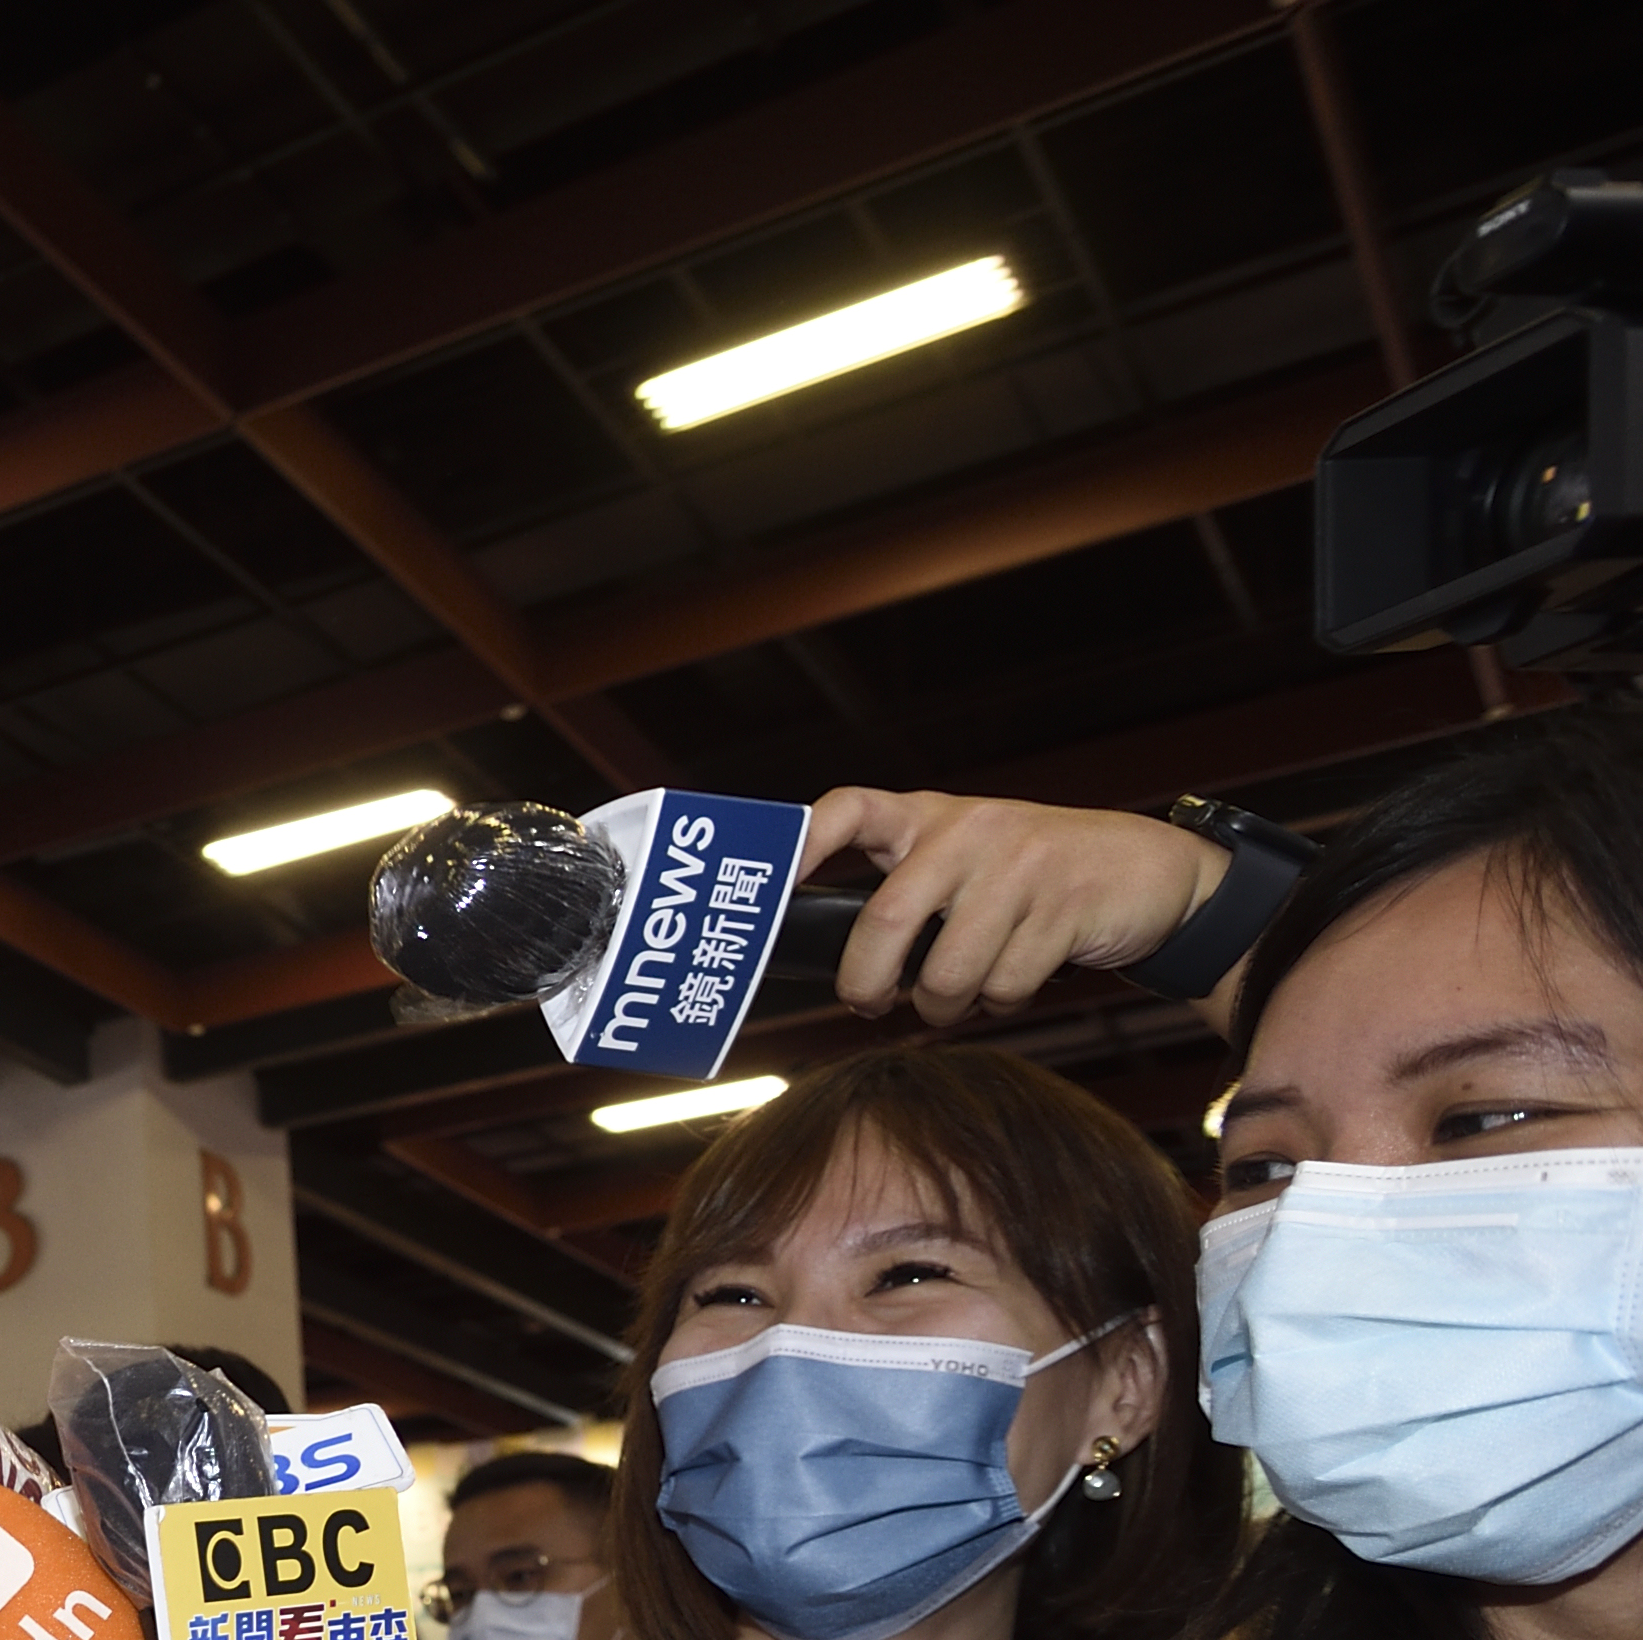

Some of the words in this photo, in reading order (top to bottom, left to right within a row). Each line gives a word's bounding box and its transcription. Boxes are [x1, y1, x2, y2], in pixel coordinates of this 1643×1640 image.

[597, 815, 715, 1052] mnews
[670, 857, 774, 1027] 鏡新聞
[199, 1149, 253, 1297] B
[931, 1359, 988, 1377] YOHO
[352, 1595, 381, 1607] NEWS
